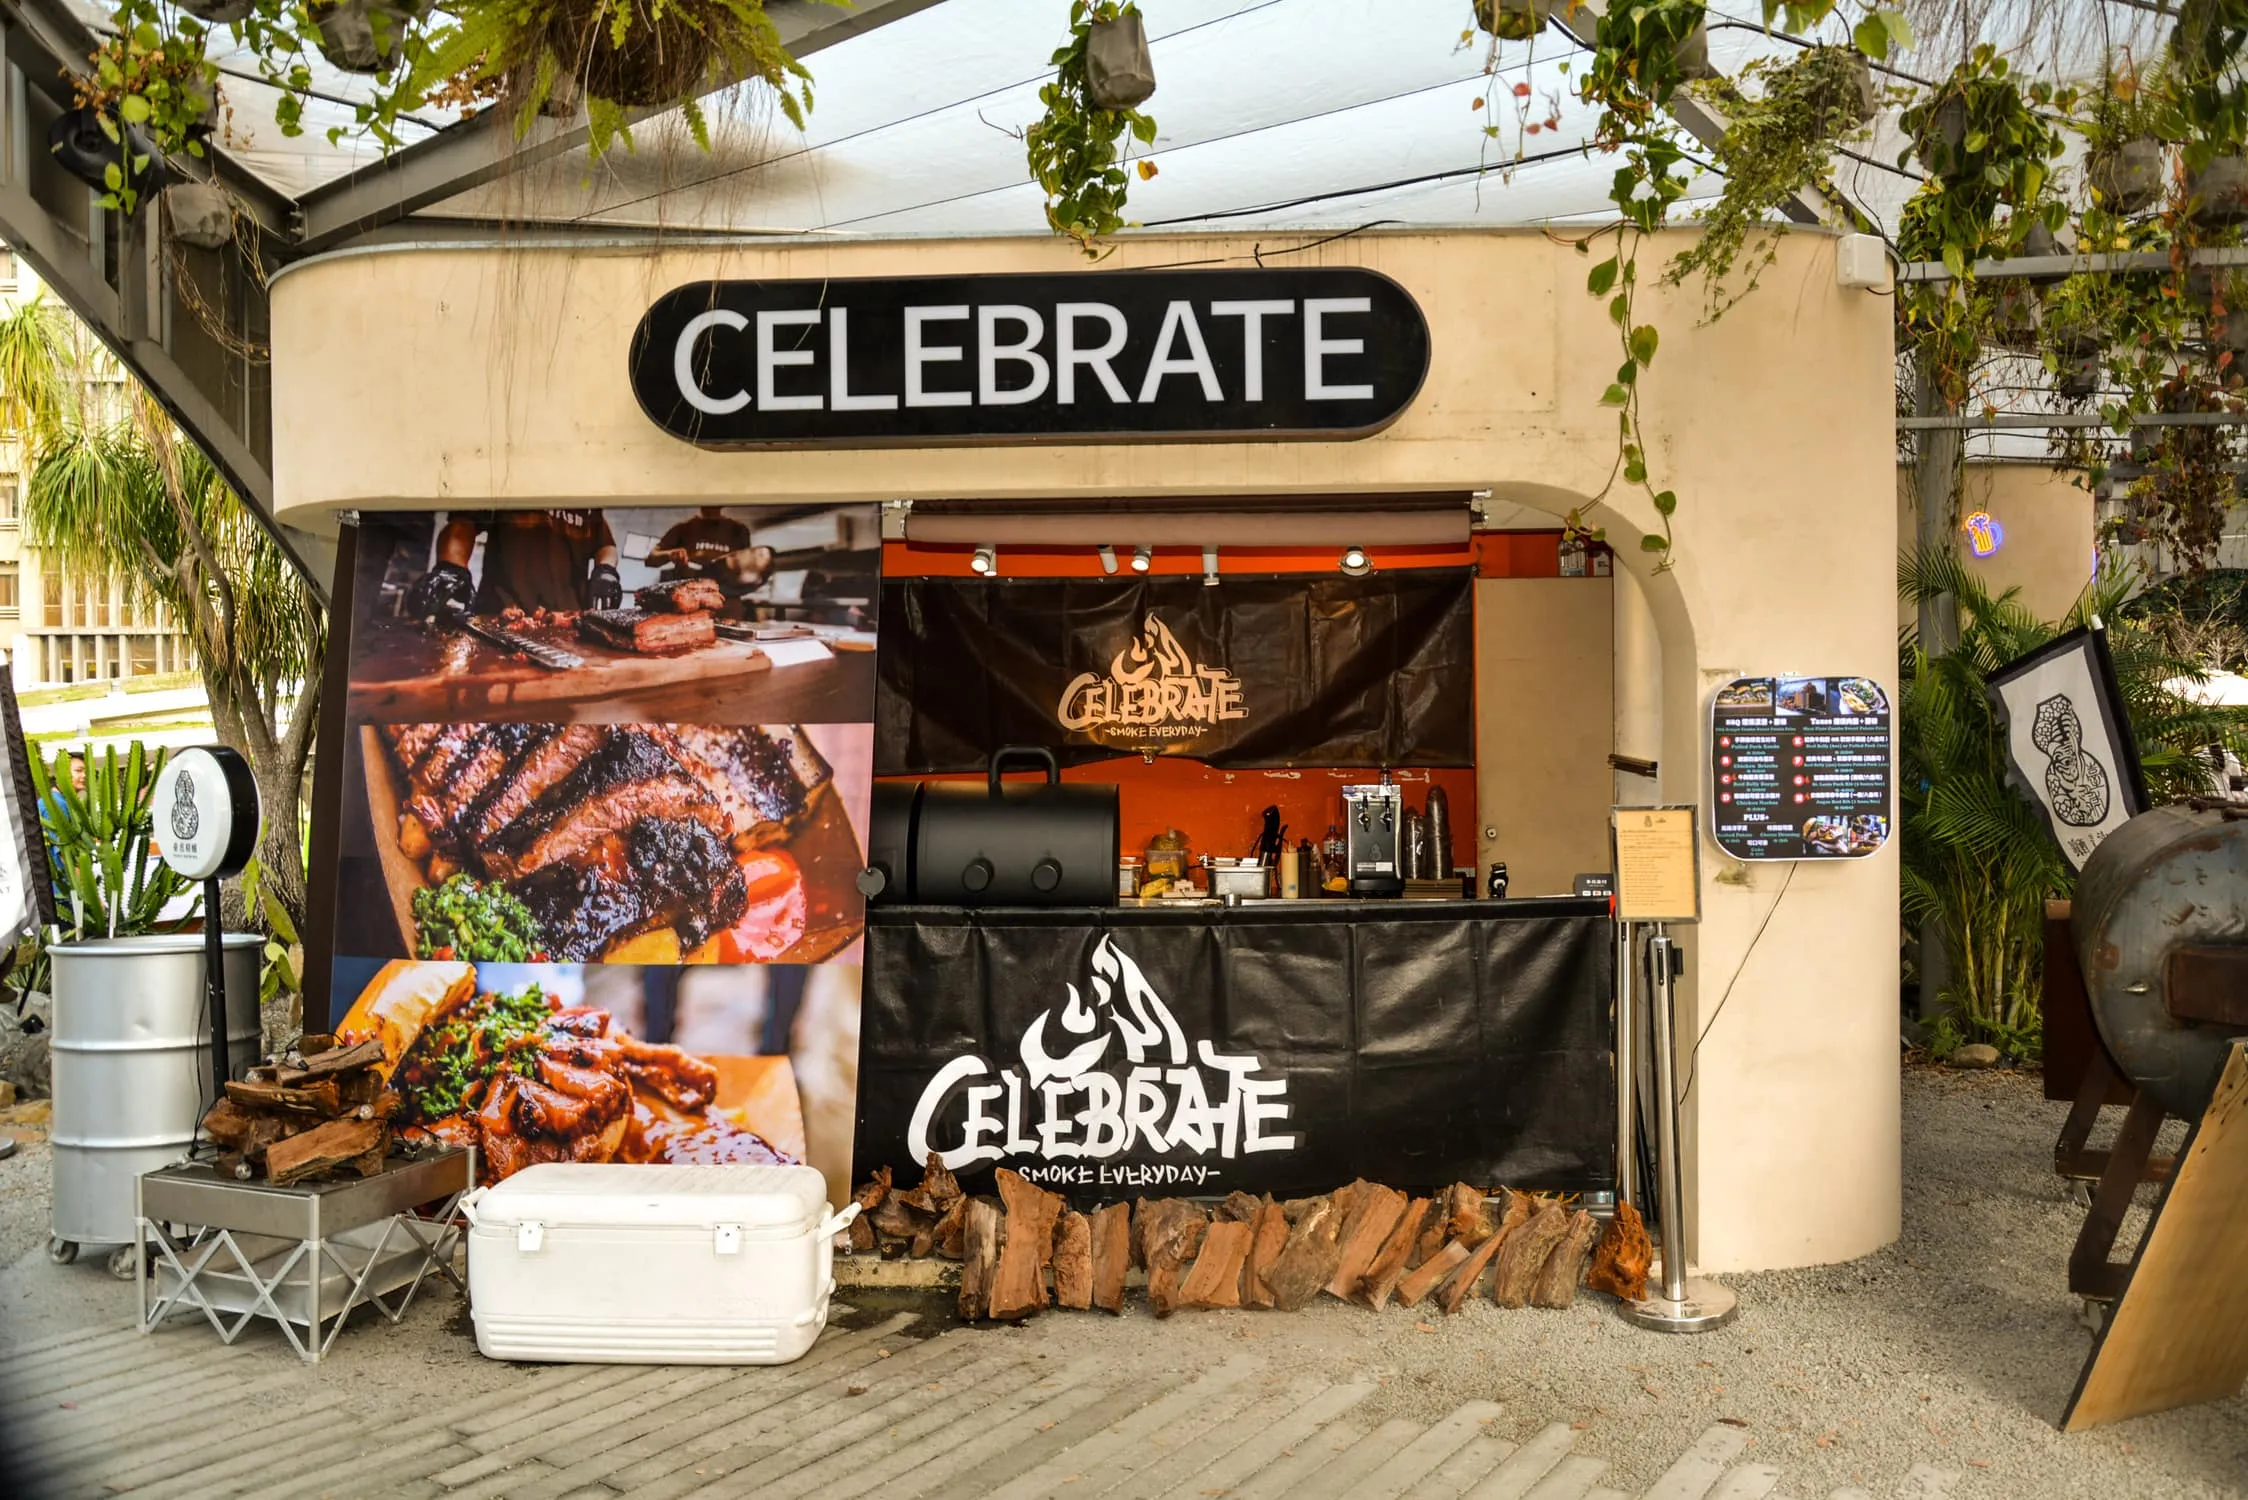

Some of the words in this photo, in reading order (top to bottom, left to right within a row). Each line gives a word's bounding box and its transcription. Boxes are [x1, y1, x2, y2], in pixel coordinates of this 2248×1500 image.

[673, 297, 1374, 416] CELEBRATE
[1058, 664, 1249, 731] CELEBRATE
[908, 1039, 1298, 1170] CELEBRATE
